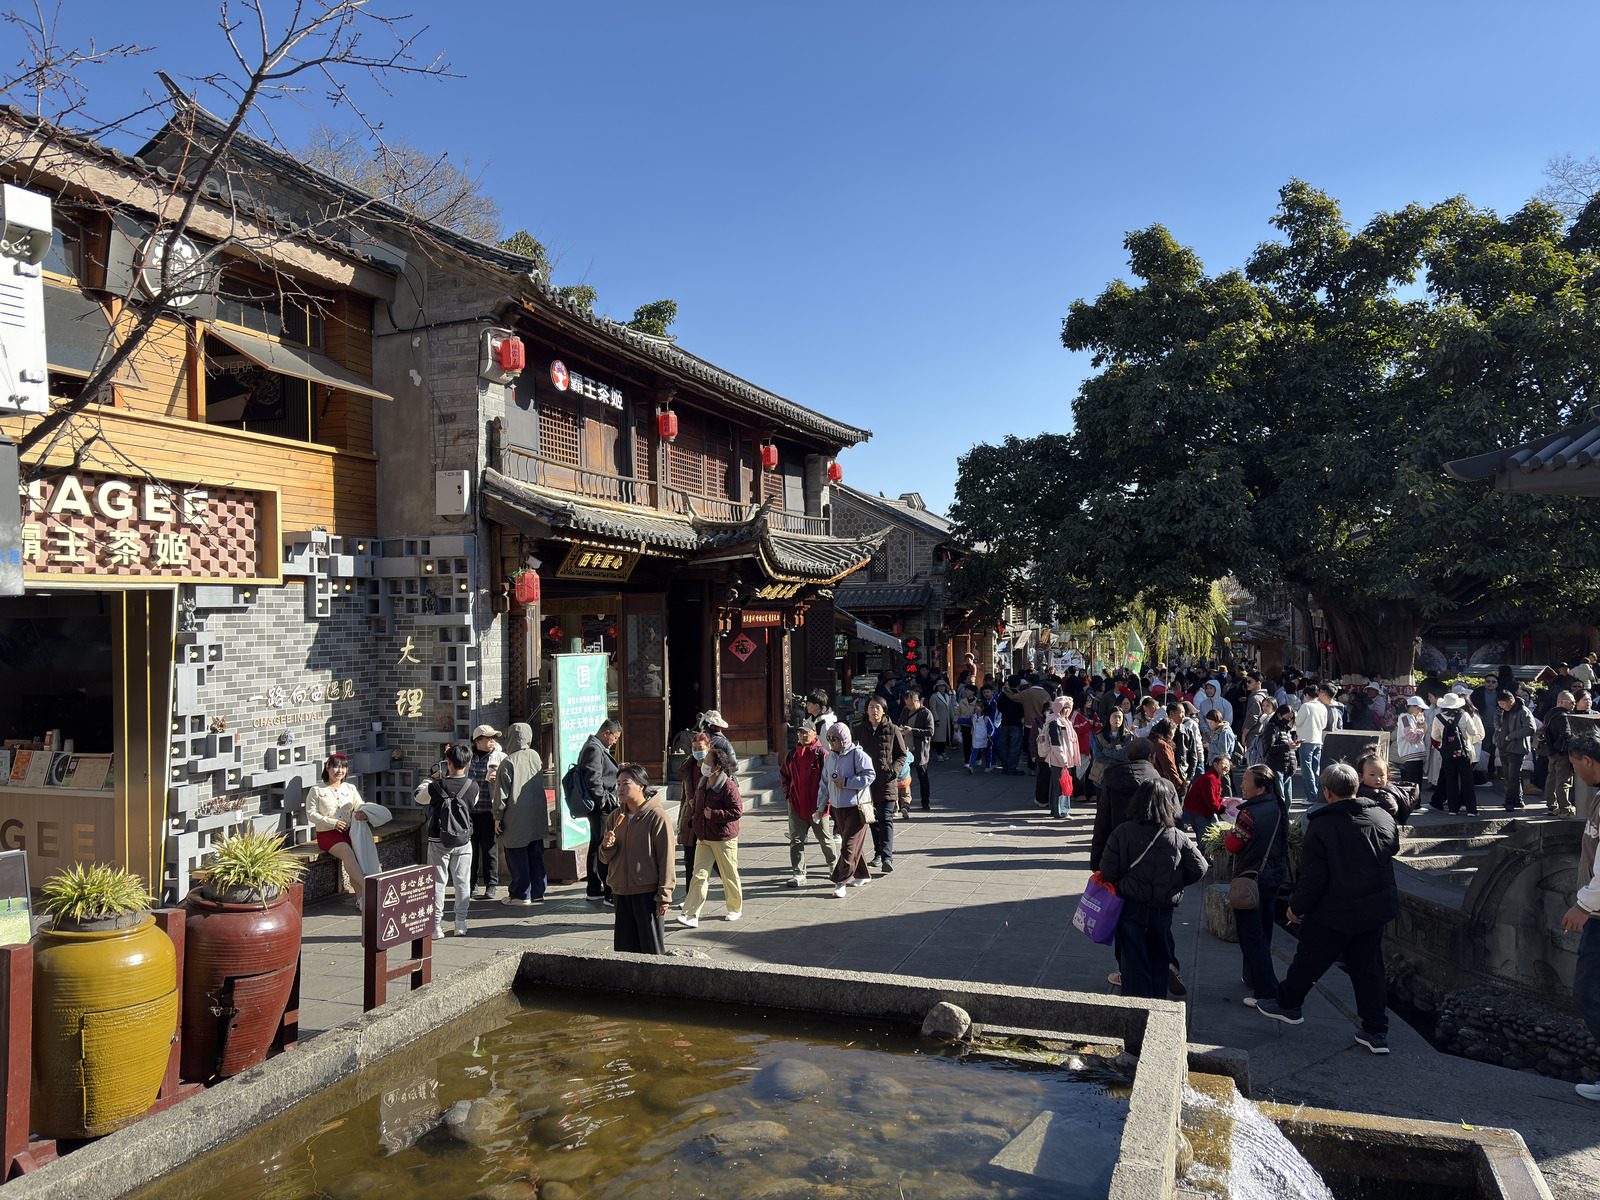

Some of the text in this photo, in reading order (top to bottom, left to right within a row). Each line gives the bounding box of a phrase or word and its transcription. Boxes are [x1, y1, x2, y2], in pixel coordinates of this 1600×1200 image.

[212, 360, 254, 376] OPERA
[569, 370, 624, 411] 霸王茶姬
[735, 639, 751, 655] 福
[396, 635, 424, 718] 大理
[247, 679, 355, 708] 一路向西遇见
[253, 711, 325, 728] CHAGEE IN DALI
[0, 819, 96, 860] GEE
[400, 874, 434, 892] 当心落水
